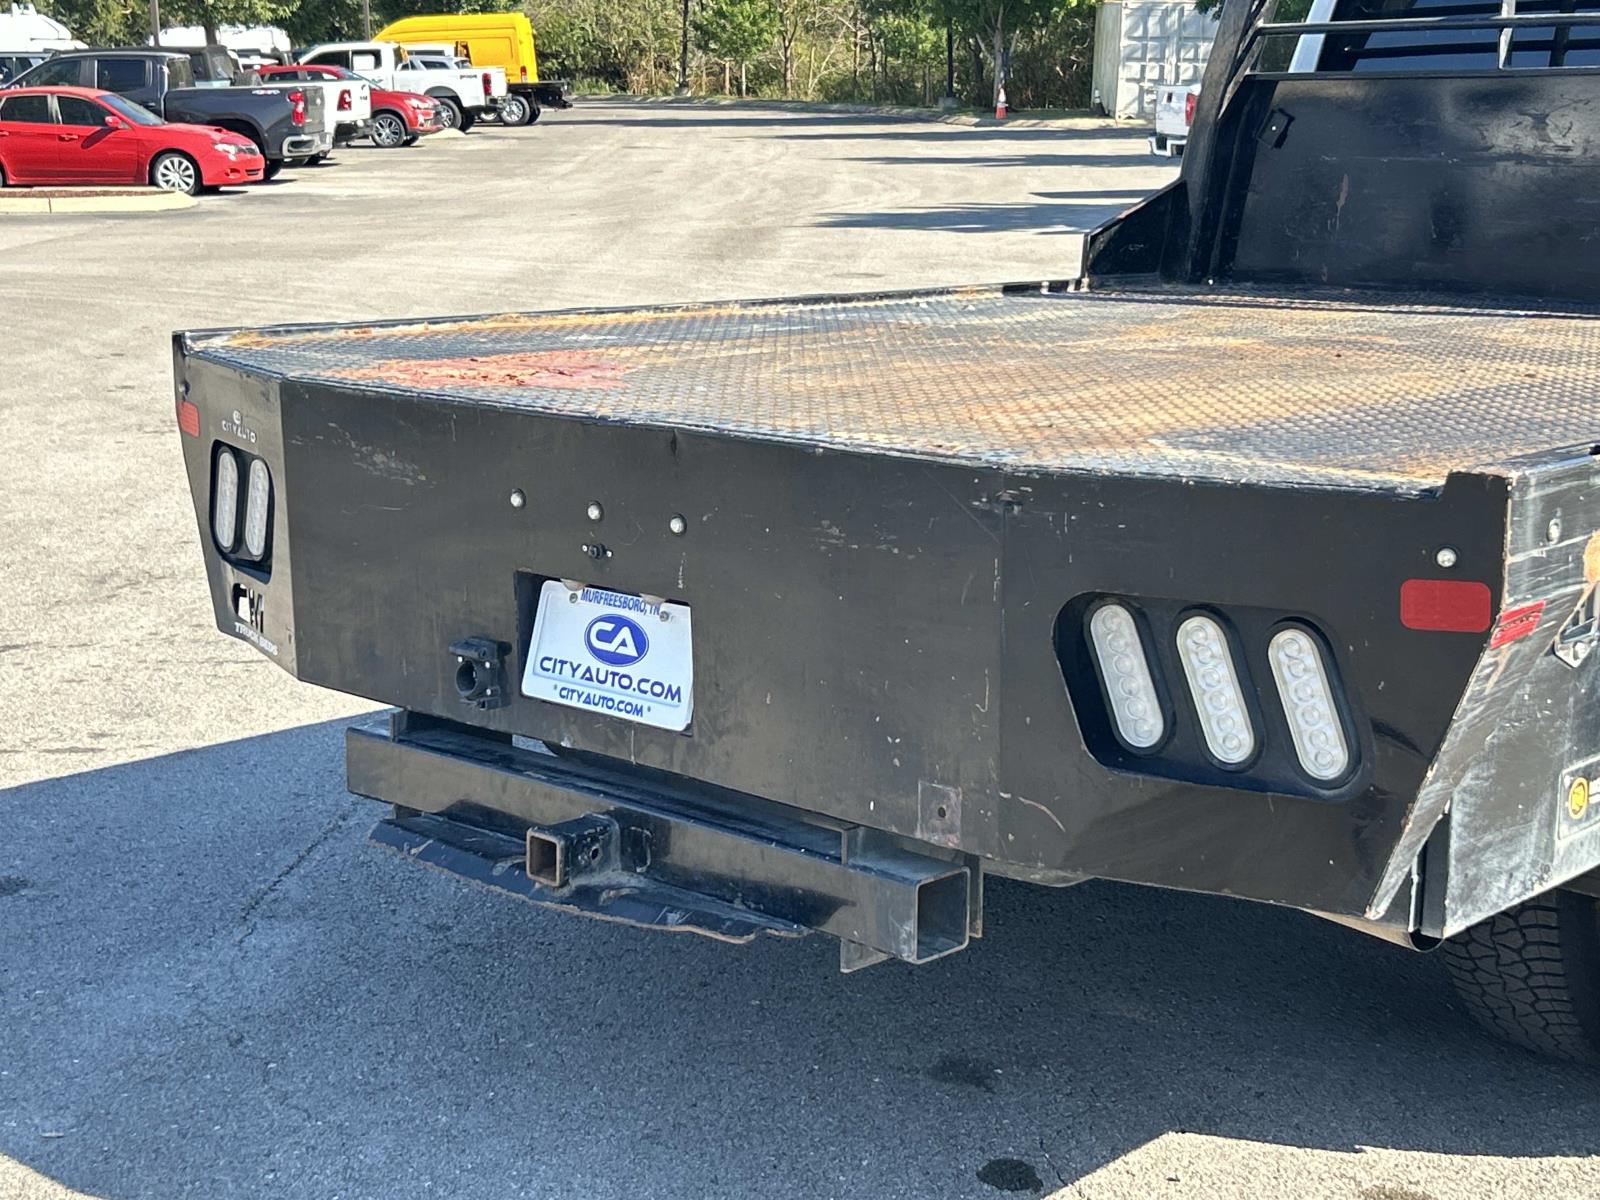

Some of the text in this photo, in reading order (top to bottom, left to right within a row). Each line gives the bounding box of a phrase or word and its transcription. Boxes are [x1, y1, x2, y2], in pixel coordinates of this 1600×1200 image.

[581, 588, 648, 616] MURFREESBORO,
[590, 621, 639, 657] CA
[539, 656, 682, 703] CITYAUTO.COM
[559, 686, 644, 717] CITYAUTO.COM
